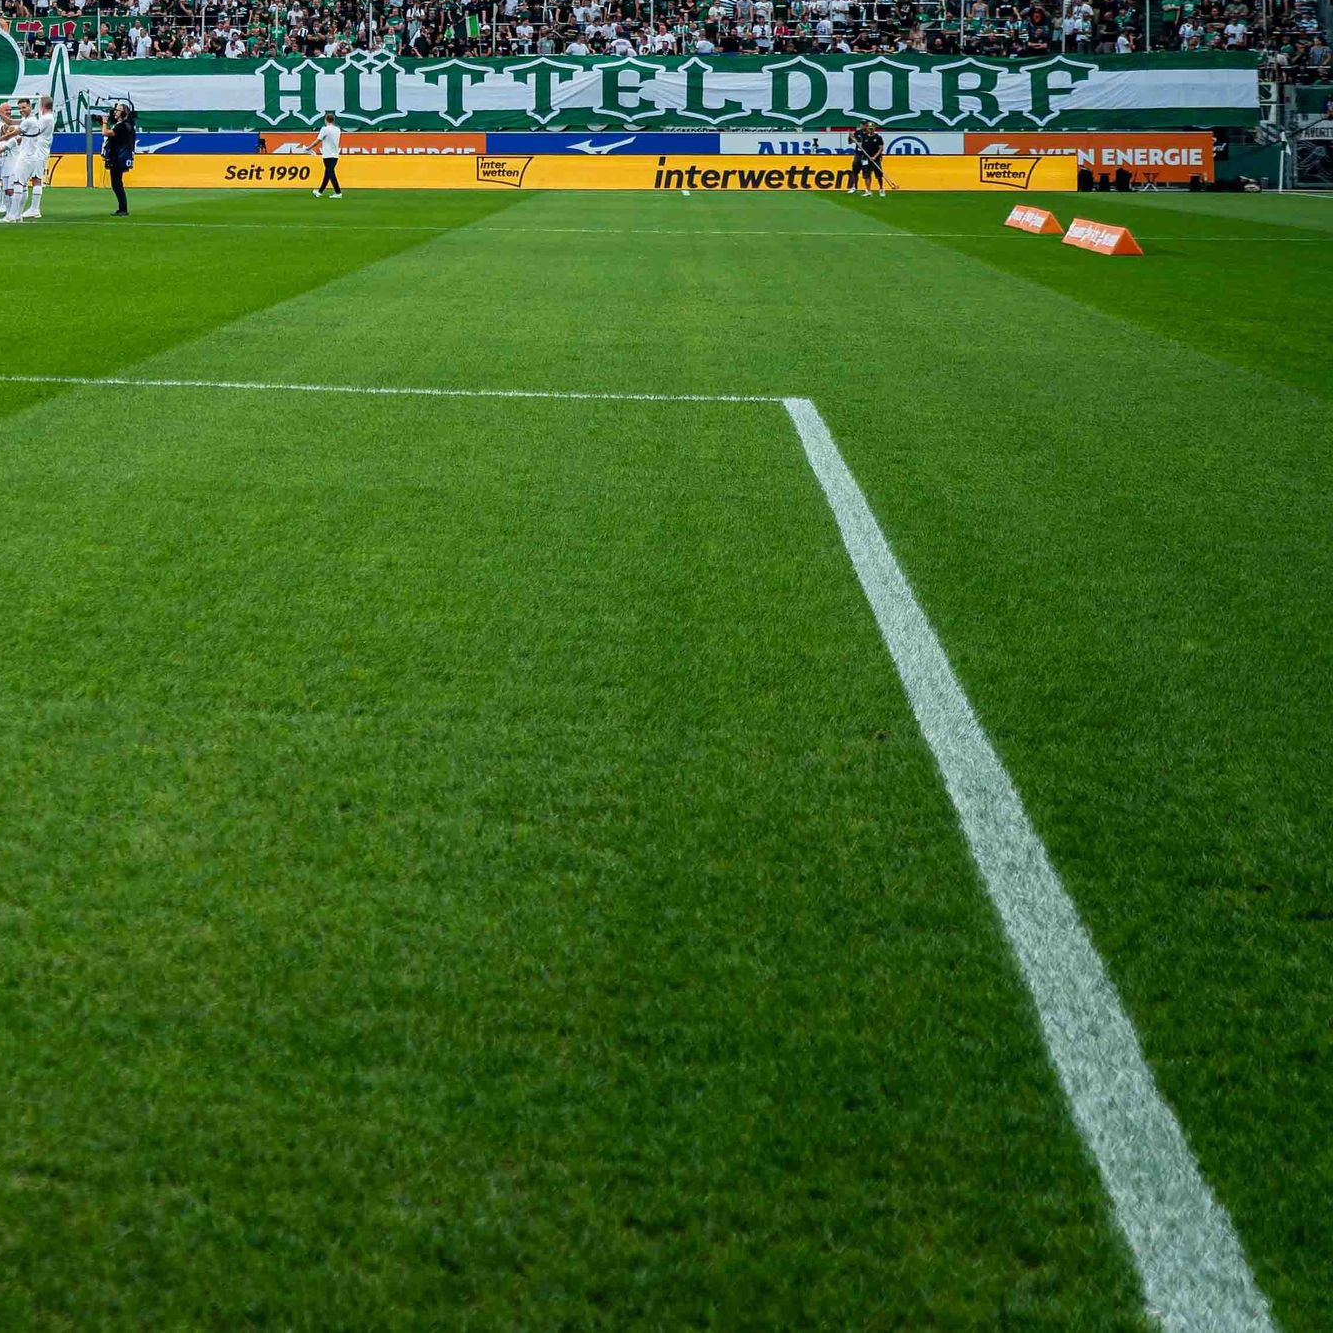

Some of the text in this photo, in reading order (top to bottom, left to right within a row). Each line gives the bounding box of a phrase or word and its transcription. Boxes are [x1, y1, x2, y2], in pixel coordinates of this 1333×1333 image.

[255, 48, 1099, 126] HÜTTELDORF
[480, 157, 507, 169] inter
[983, 157, 1012, 170] inter
[1101, 147, 1203, 166] ENERGIE
[225, 164, 311, 180] Seit 1990
[483, 168, 520, 178] wetten
[654, 156, 855, 189] interwetten
[986, 169, 1026, 179] wetten
